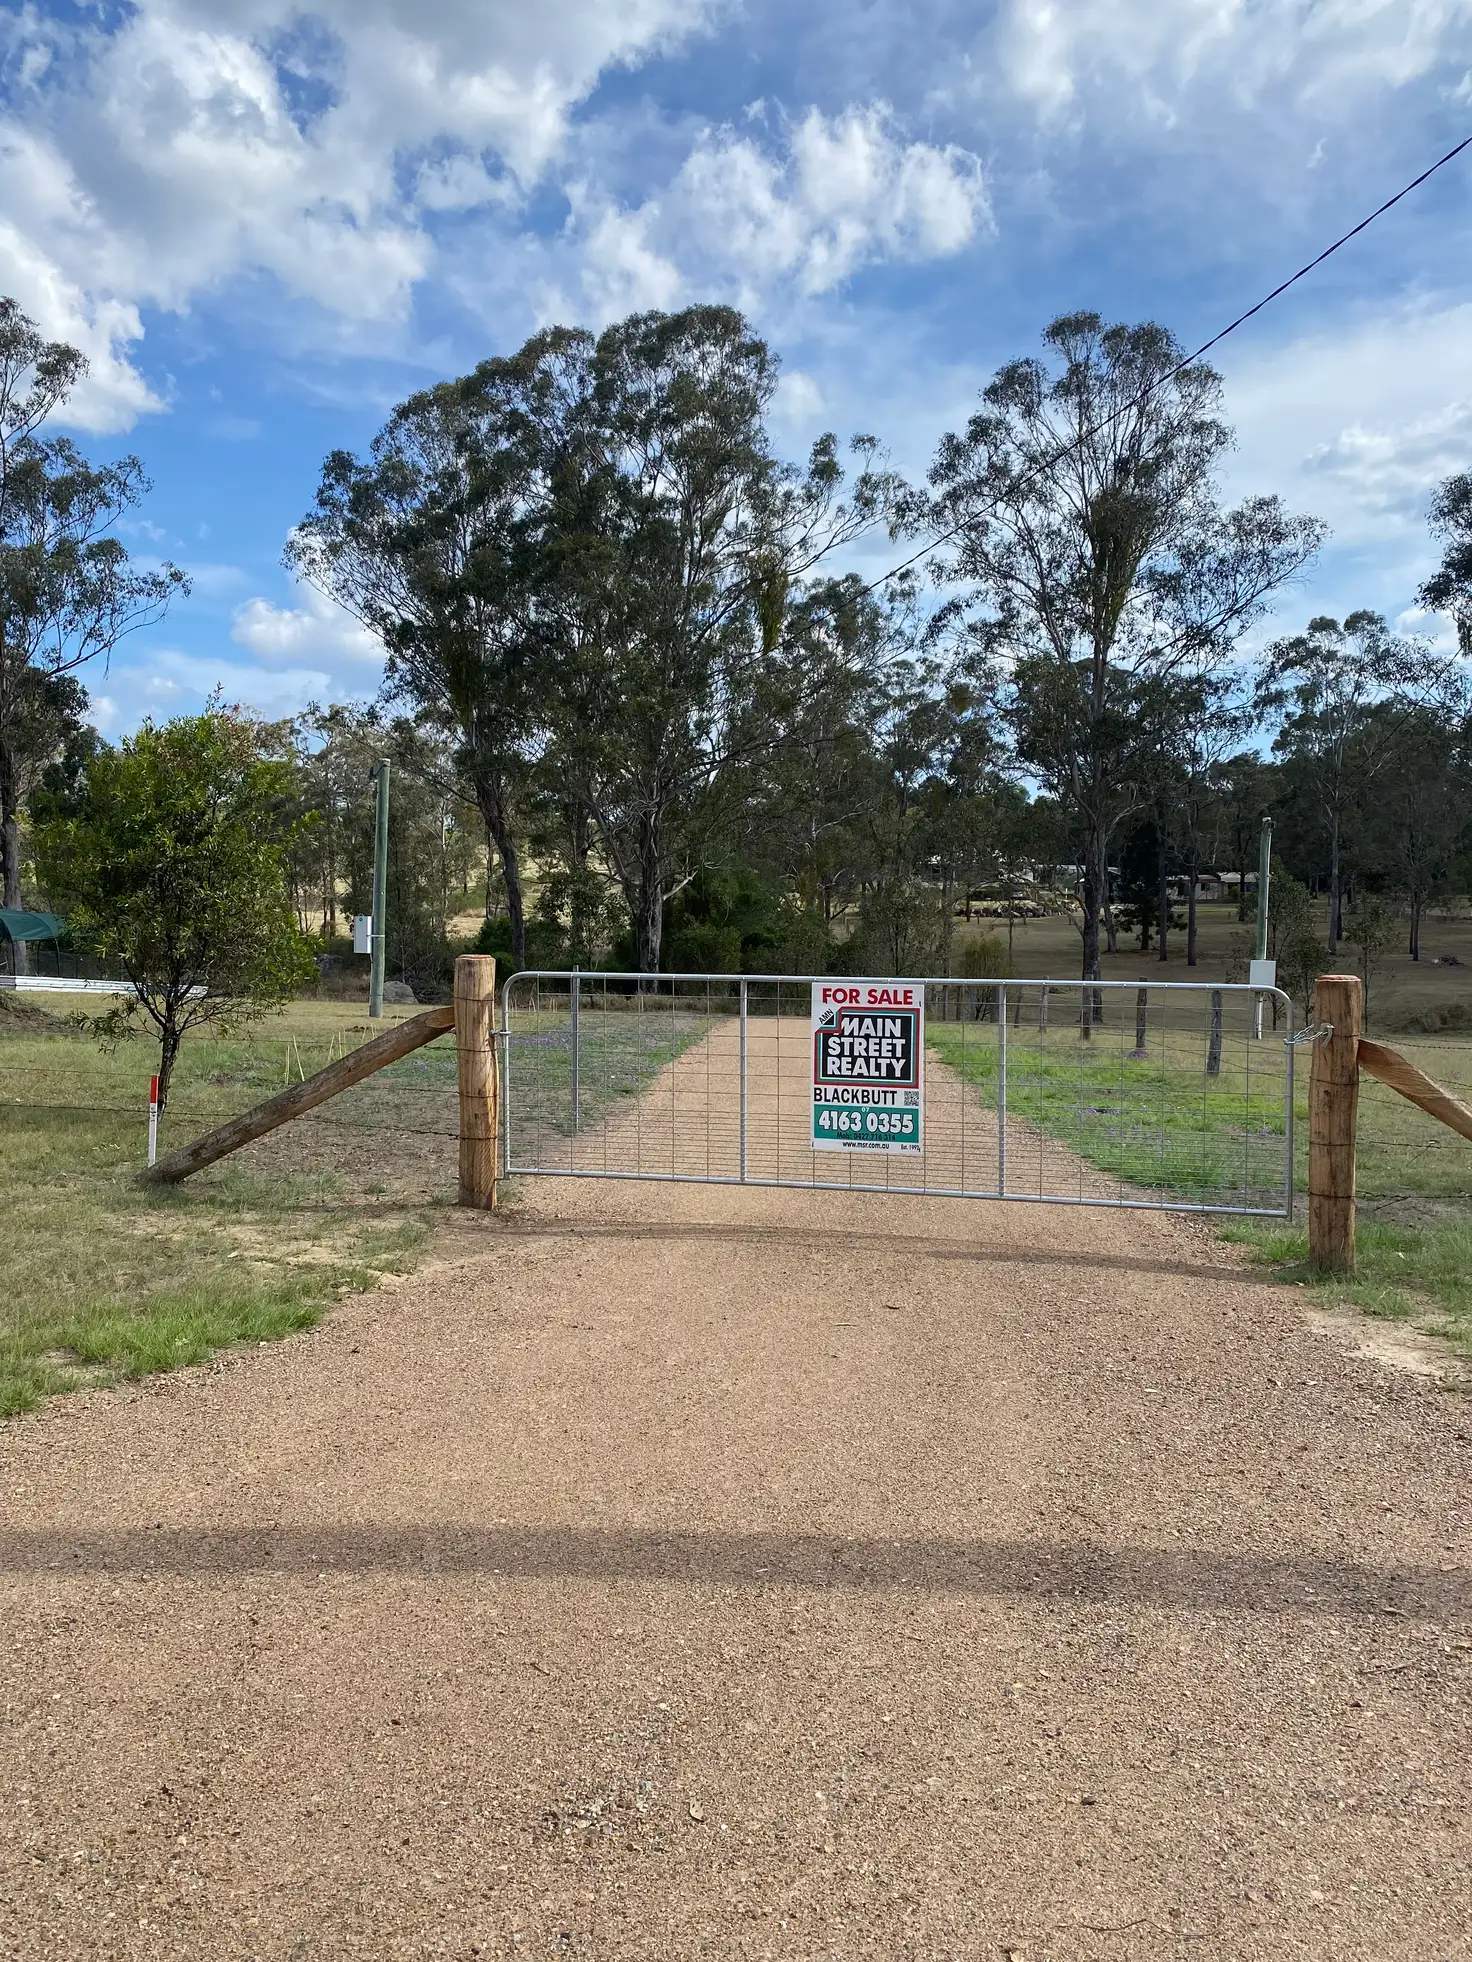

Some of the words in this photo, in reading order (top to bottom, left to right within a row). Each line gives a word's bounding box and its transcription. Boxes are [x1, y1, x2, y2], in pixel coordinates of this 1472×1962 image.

[822, 988, 860, 1004] FOR
[867, 989, 913, 1005] SALE
[818, 1008, 834, 1024] AMN
[841, 1018, 901, 1037] MAIN
[828, 1037, 906, 1057] STREET
[827, 1057, 906, 1077] REALTY
[813, 1087, 897, 1105] BLACKBUTT
[818, 1110, 862, 1132] 4163
[866, 1112, 914, 1134] 0355
[842, 1141, 890, 1150] www.msr.com.au
